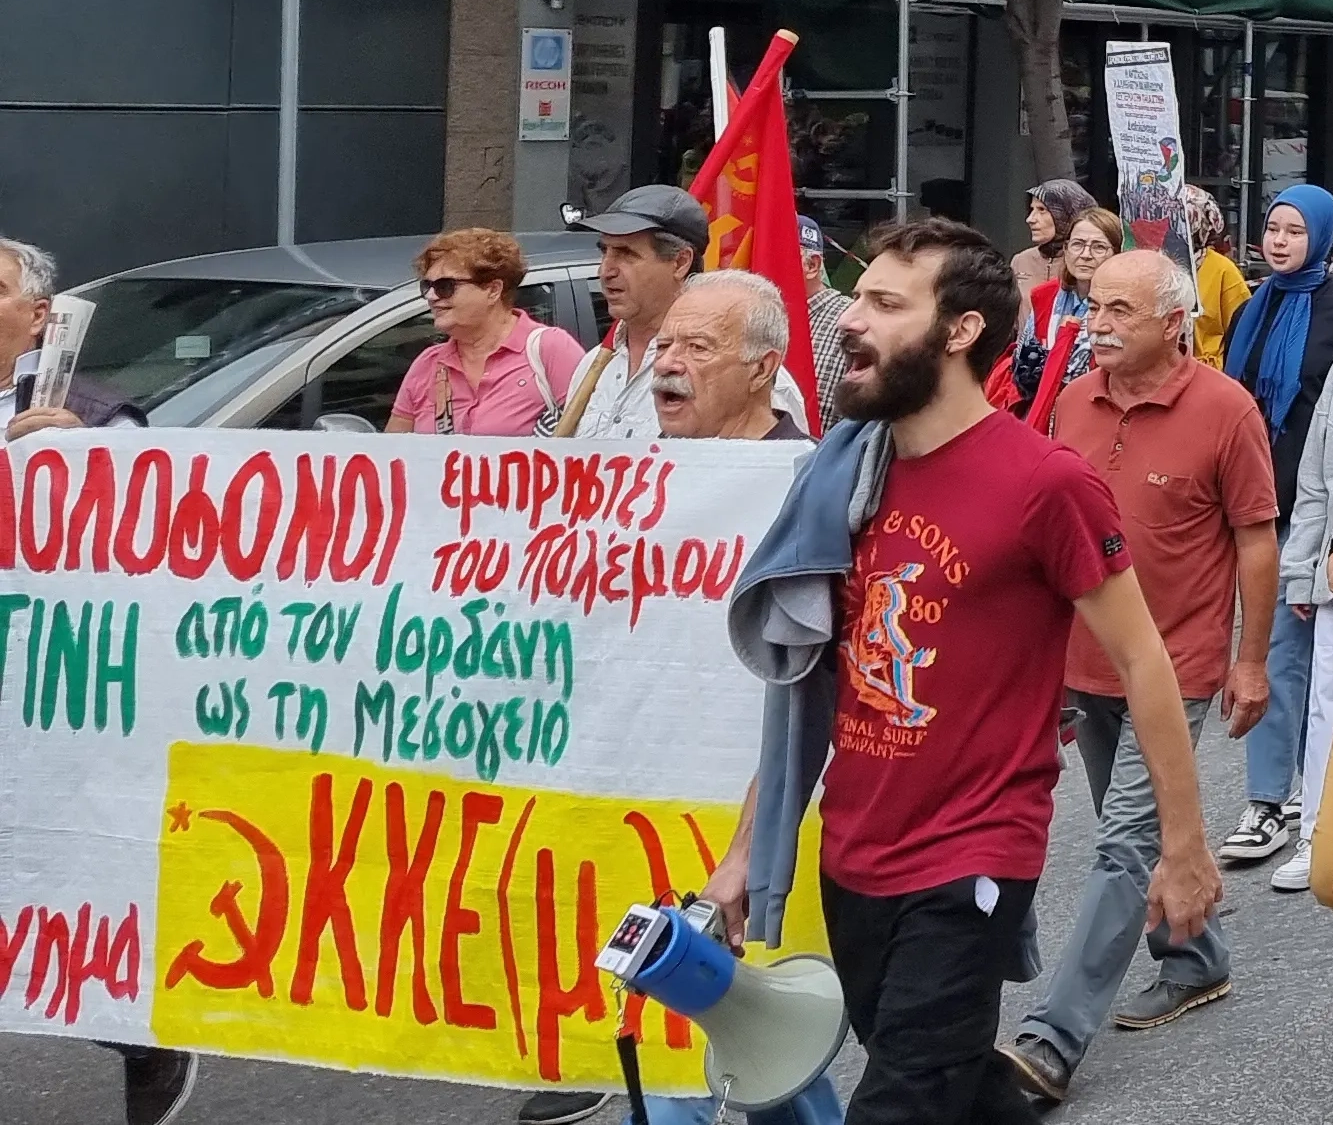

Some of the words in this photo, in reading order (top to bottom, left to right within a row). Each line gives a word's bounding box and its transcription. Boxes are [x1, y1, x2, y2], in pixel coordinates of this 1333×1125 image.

[525, 80, 566, 90] RICOH
[906, 515, 970, 588] SONS
[176, 583, 269, 661] από
[280, 601, 362, 664] τον
[375, 582, 572, 704] Ιορδάνη
[196, 677, 250, 741] ως
[267, 681, 329, 756] τη
[353, 679, 571, 784] Μεσόγειο
[883, 726, 927, 746] SURF
